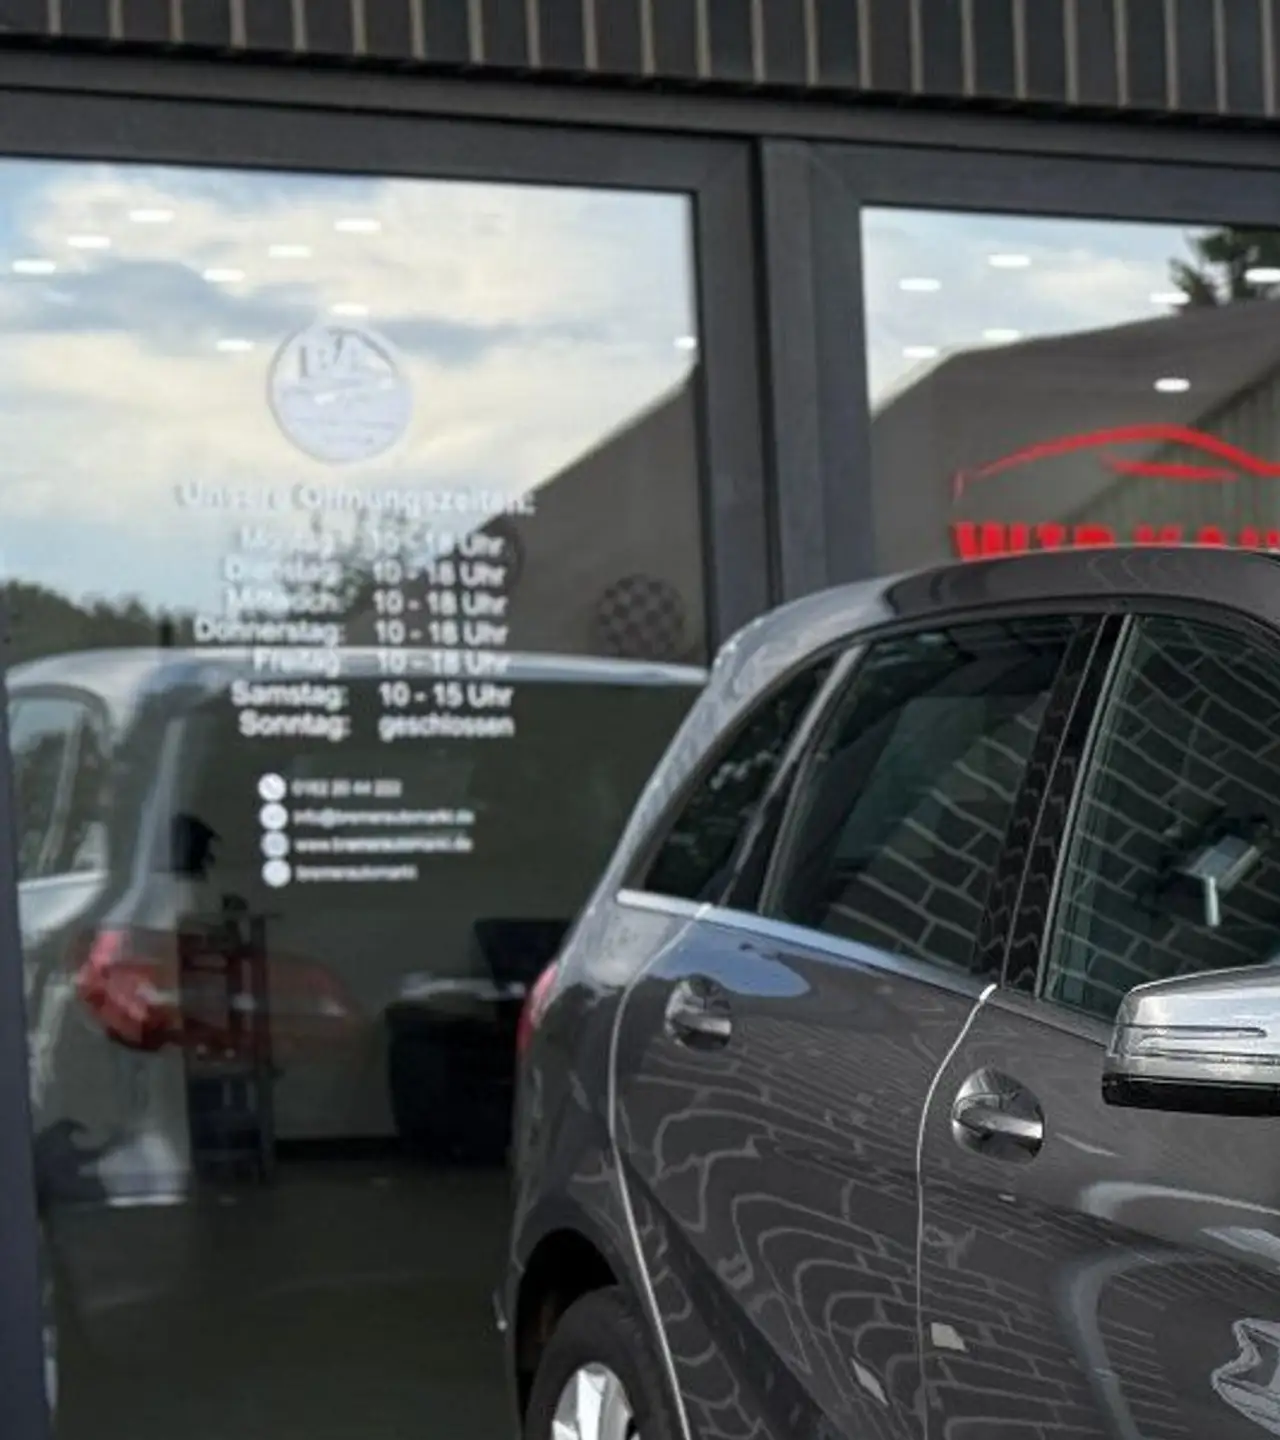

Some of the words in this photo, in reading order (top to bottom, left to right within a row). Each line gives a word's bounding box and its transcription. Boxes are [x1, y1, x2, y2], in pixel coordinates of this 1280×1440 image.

[459, 532, 505, 558] Uhr
[372, 559, 402, 585] 10
[459, 560, 506, 588] Uhr
[373, 588, 404, 615] 10
[427, 588, 457, 616] 18
[462, 589, 509, 617] Uhr
[375, 619, 406, 645] 10
[429, 619, 459, 646] 18
[463, 620, 510, 646] Uhr
[377, 649, 407, 675] 10
[464, 650, 511, 677] Uhr
[231, 679, 349, 712] Samstag:
[379, 680, 411, 708] 10
[433, 680, 464, 708] 15
[467, 681, 515, 708] Uhr
[238, 708, 351, 742] Sonntag:
[378, 712, 515, 743] geschlossen
